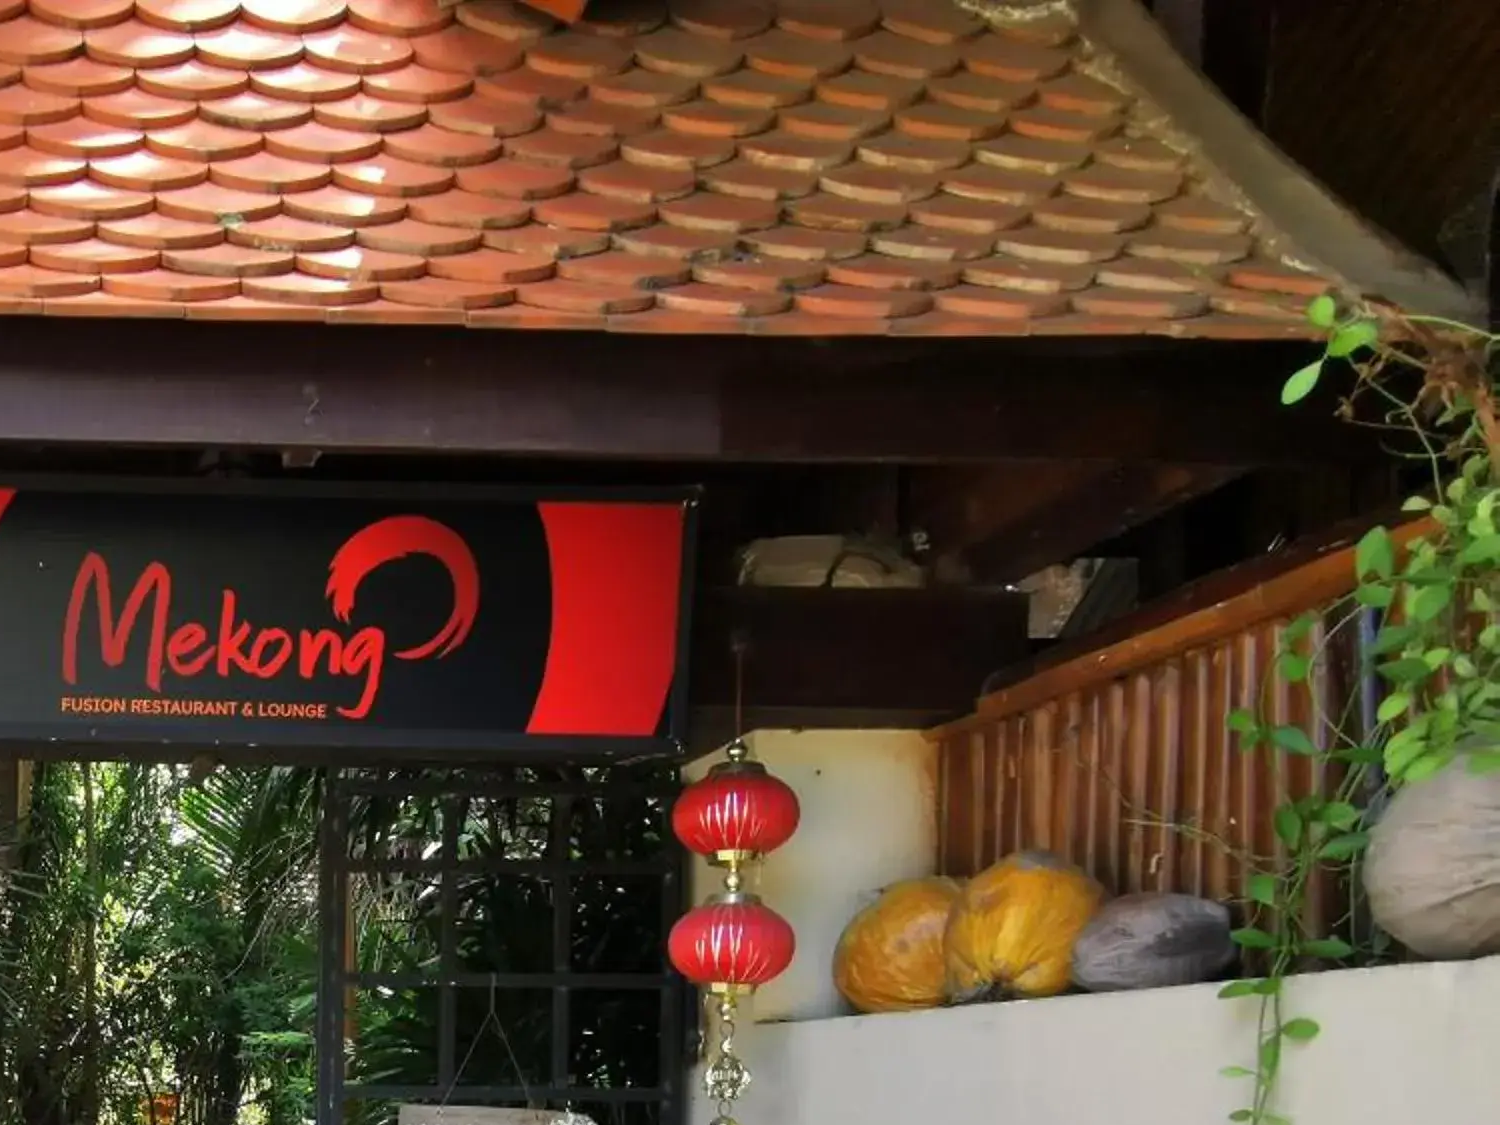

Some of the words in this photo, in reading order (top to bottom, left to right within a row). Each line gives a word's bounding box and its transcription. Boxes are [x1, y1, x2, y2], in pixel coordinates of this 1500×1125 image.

[62, 551, 385, 719] Mekong
[61, 697, 126, 714] FUSION
[130, 699, 237, 717] RESTAURANT
[241, 702, 254, 717] &
[258, 702, 328, 719] LOUNGE
